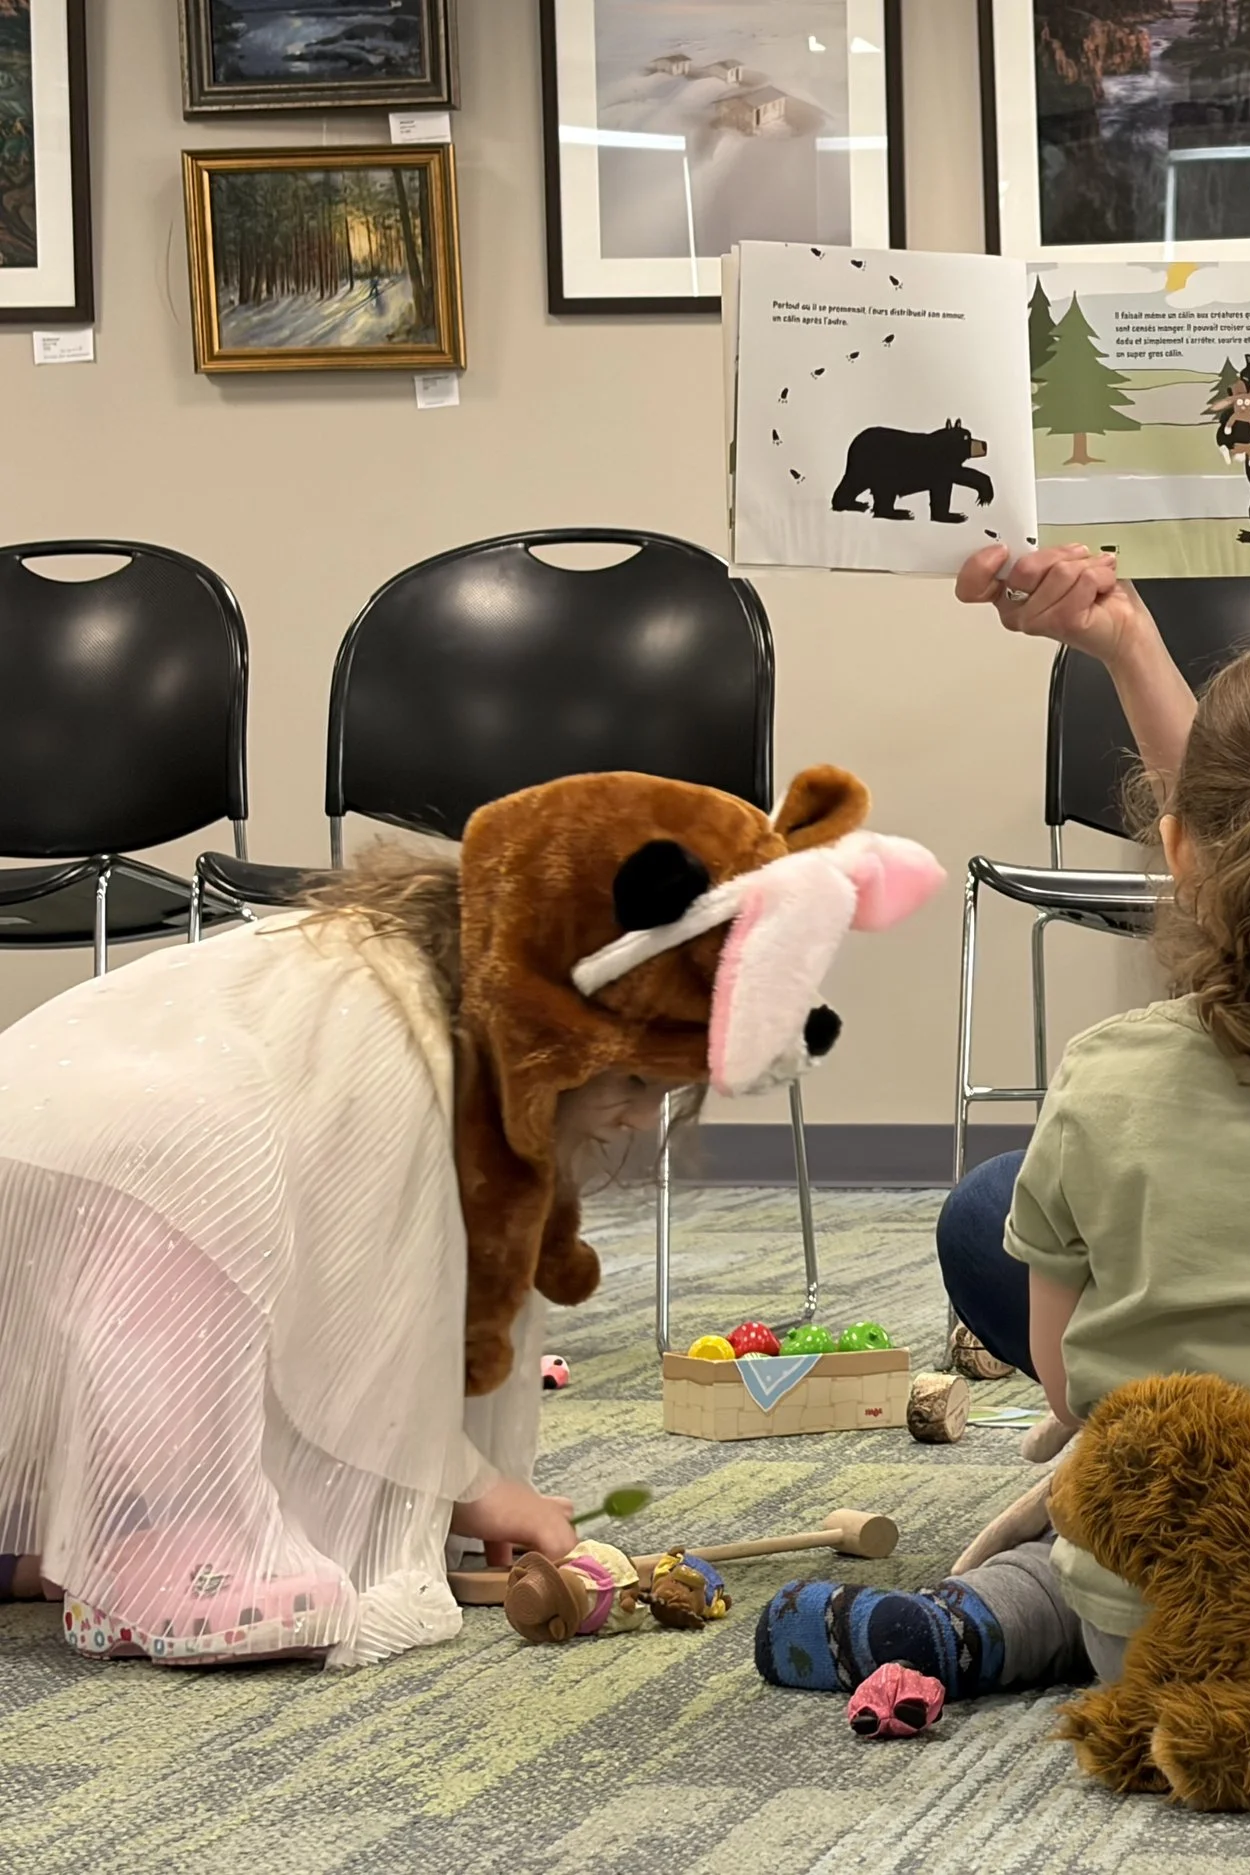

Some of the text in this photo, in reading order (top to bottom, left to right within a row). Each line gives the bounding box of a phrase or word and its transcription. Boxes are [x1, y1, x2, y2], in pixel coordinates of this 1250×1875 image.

[773, 301, 800, 309] Partout
[812, 303, 817, 311] il
[828, 305, 867, 314] promenait,
[868, 306, 888, 316] l'ours
[890, 308, 927, 318] distribuait
[783, 314, 801, 323] câlin
[802, 316, 822, 325] après
[823, 317, 848, 326] l'autre.
[1115, 311, 1120, 319] Il
[1121, 311, 1143, 319] faisait
[1178, 311, 1195, 319] câlin
[1210, 311, 1243, 319] créatures
[1131, 324, 1156, 332] censés
[1186, 323, 1192, 331] Il
[1193, 323, 1218, 333] pouvait
[1116, 337, 1133, 345] dodu
[1135, 337, 1142, 345] et
[1144, 337, 1184, 346] simplement
[1218, 336, 1242, 344] sourire
[1244, 336, 1250, 344] et
[1127, 351, 1146, 359] super
[1148, 351, 1164, 360] gros
[1165, 349, 1184, 358] câlin.
